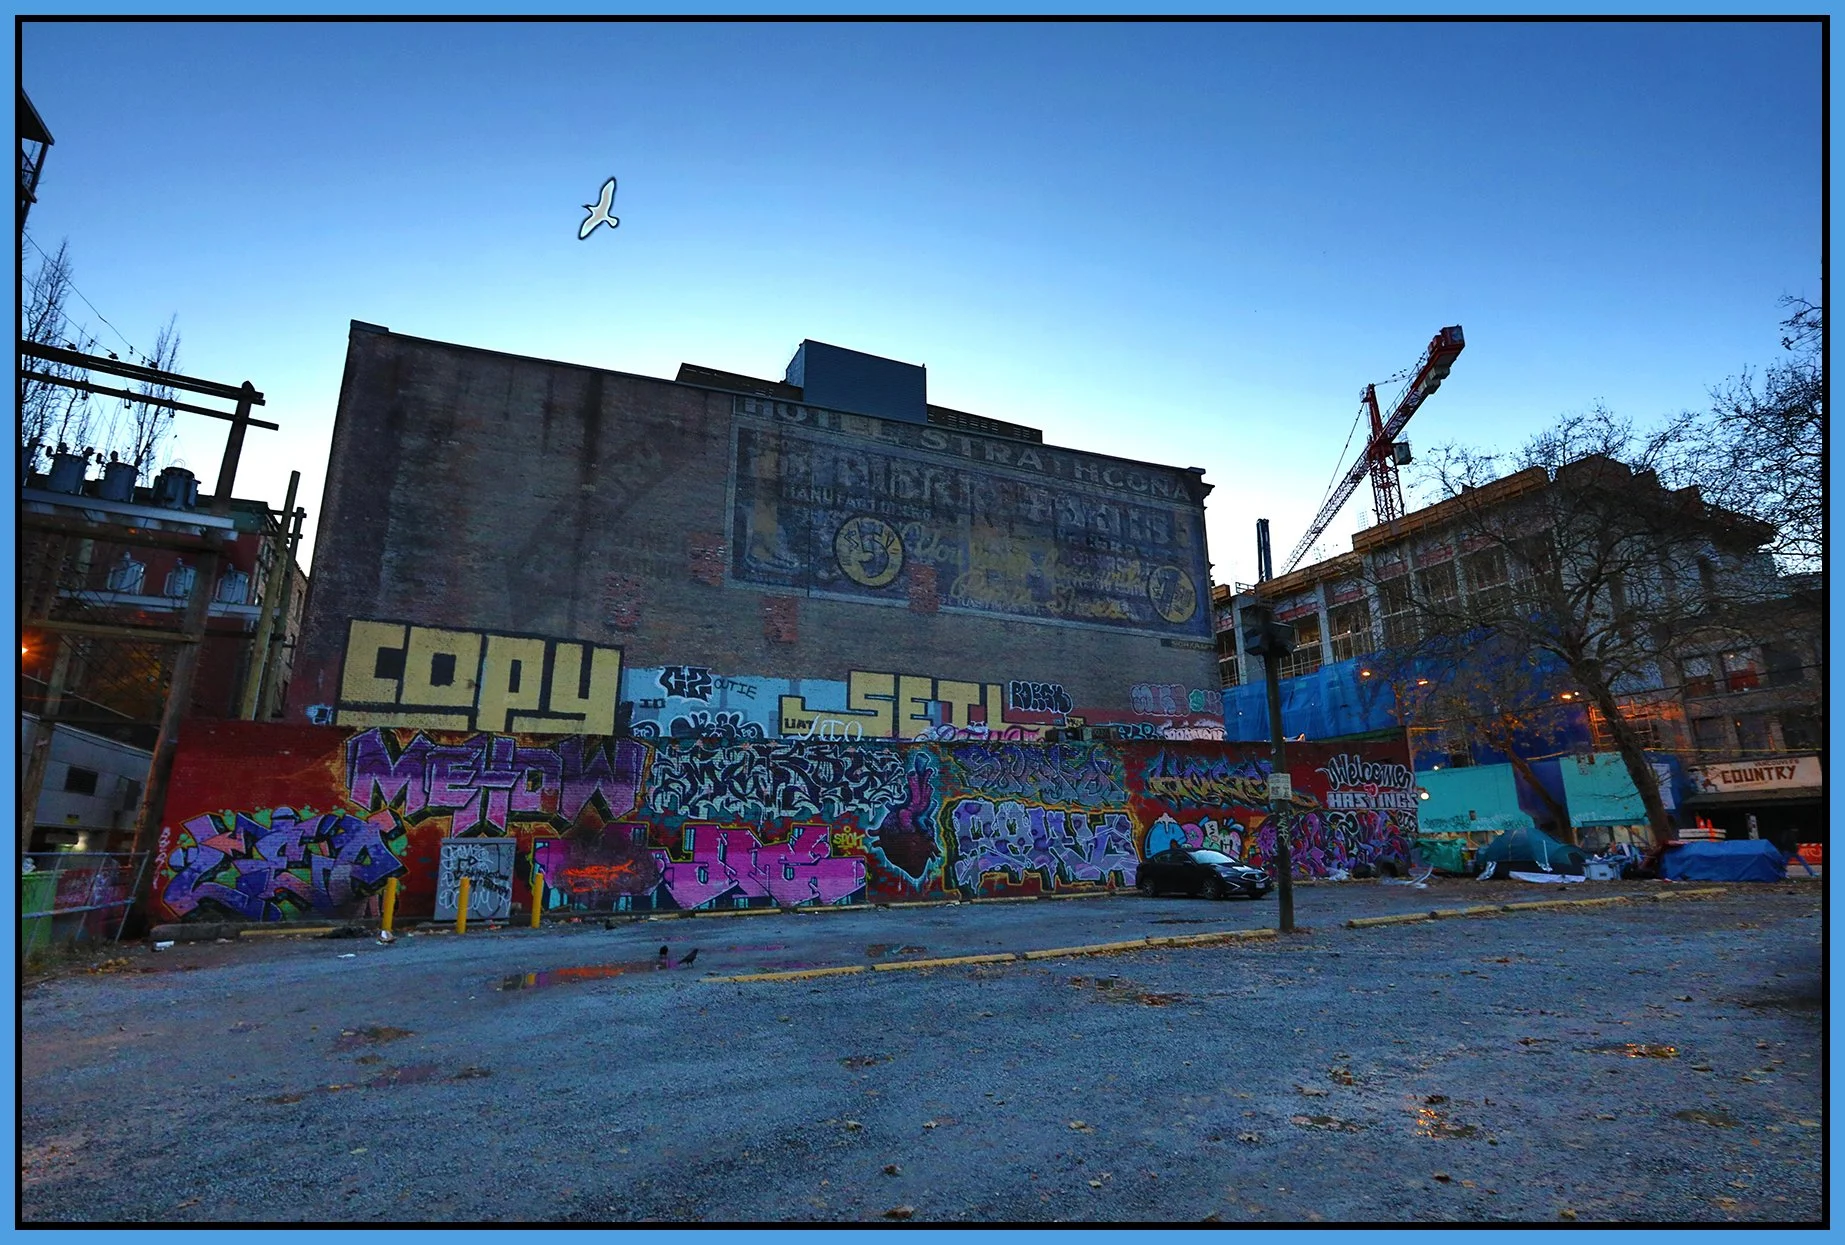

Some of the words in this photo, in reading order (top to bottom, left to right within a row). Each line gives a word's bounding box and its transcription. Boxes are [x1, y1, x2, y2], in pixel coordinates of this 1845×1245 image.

[336, 619, 624, 736] COPY
[1721, 765, 1796, 785] COUNTRY
[1327, 791, 1419, 809] HASTINGS
